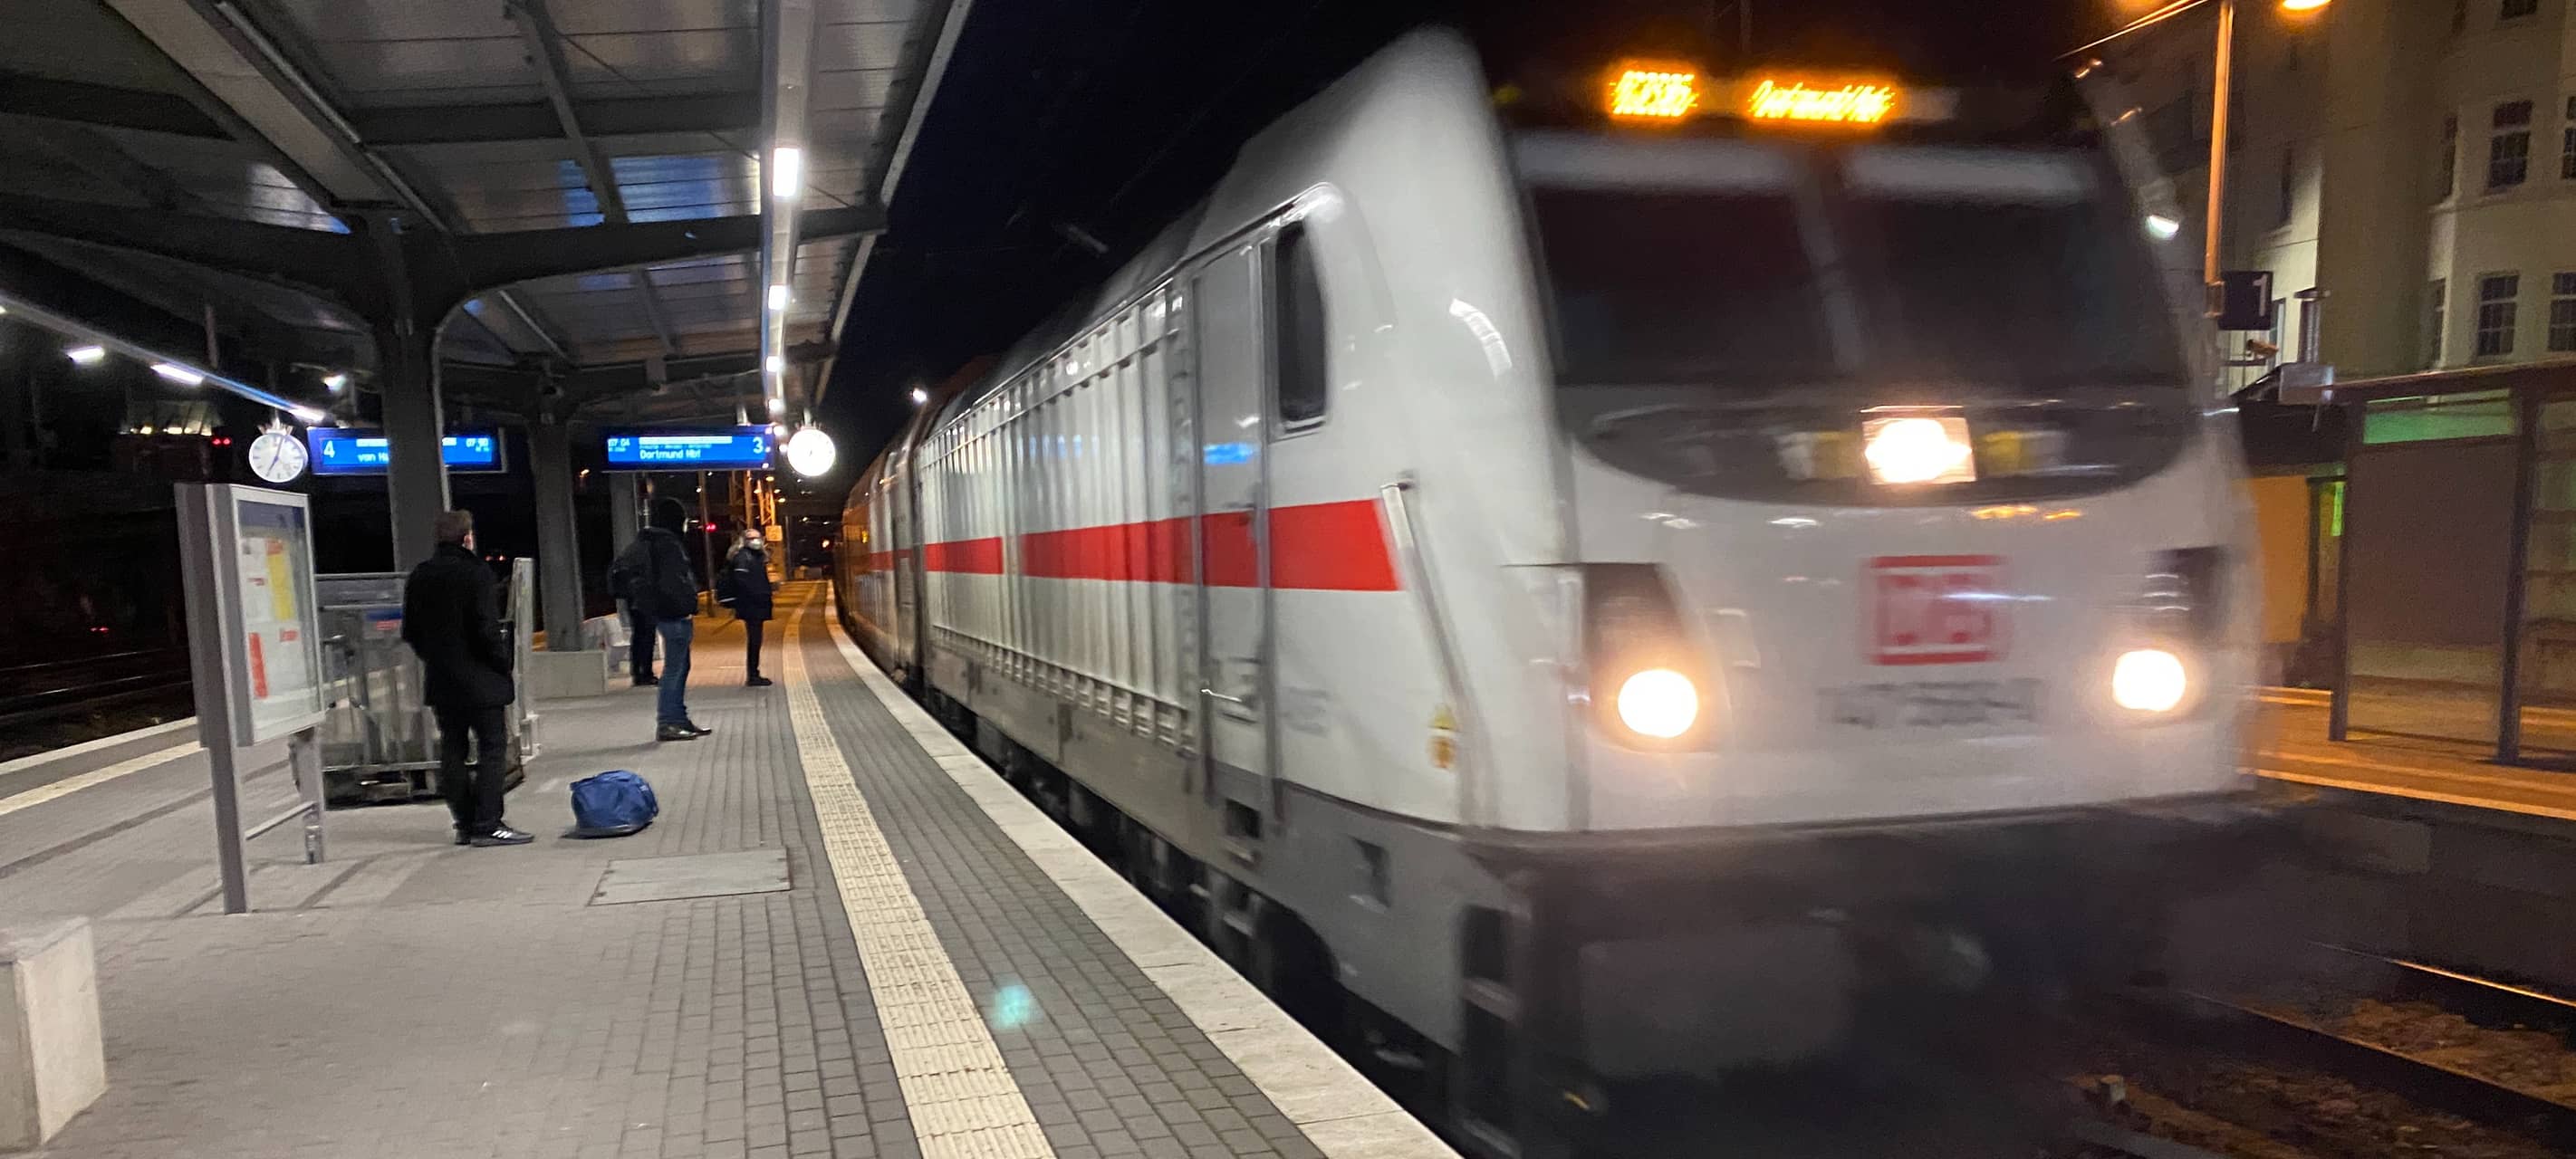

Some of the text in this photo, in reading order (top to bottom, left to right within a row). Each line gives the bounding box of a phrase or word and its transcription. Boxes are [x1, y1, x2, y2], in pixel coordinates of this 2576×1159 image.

[2253, 273, 2268, 317] 1
[323, 440, 335, 458] 4
[639, 449, 684, 459] Dortmund
[753, 436, 764, 454] 3
